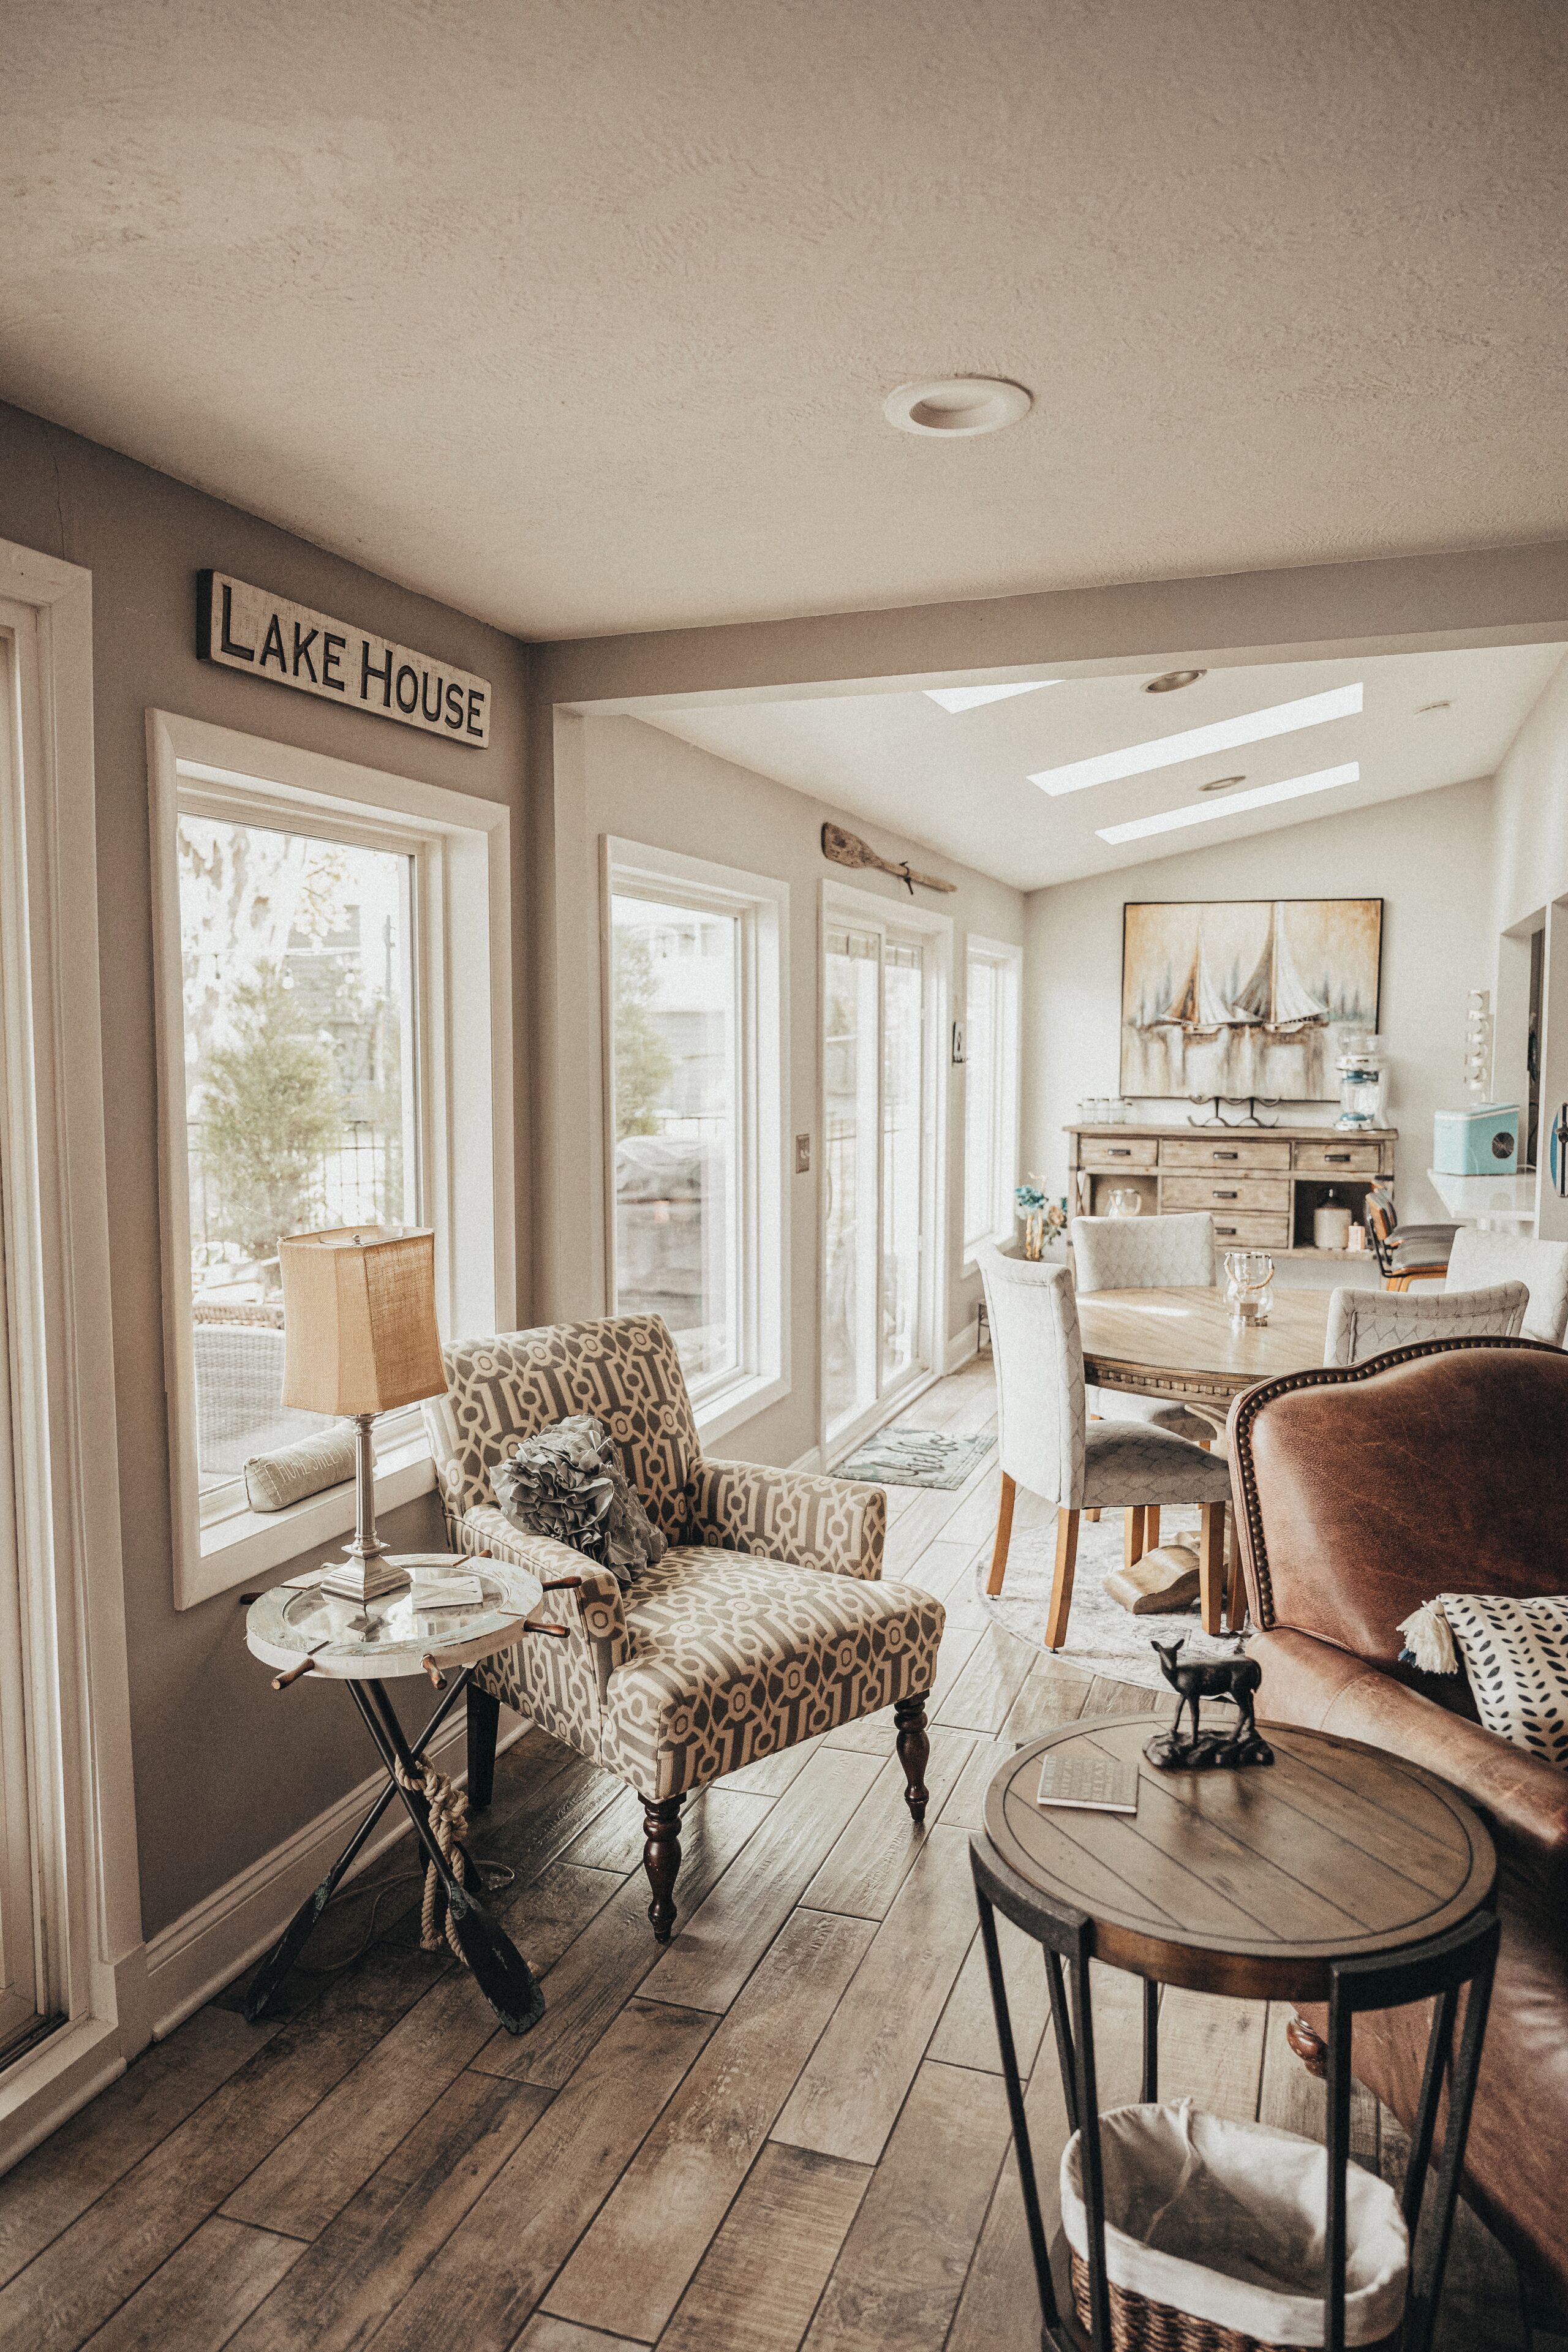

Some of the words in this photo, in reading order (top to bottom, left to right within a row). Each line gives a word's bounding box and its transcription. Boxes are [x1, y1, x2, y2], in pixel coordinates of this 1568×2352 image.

[221, 585, 346, 692] LAKE
[360, 640, 484, 737] HOUSE
[270, 1450, 311, 1482] HOME
[301, 1440, 344, 1471] SWEET
